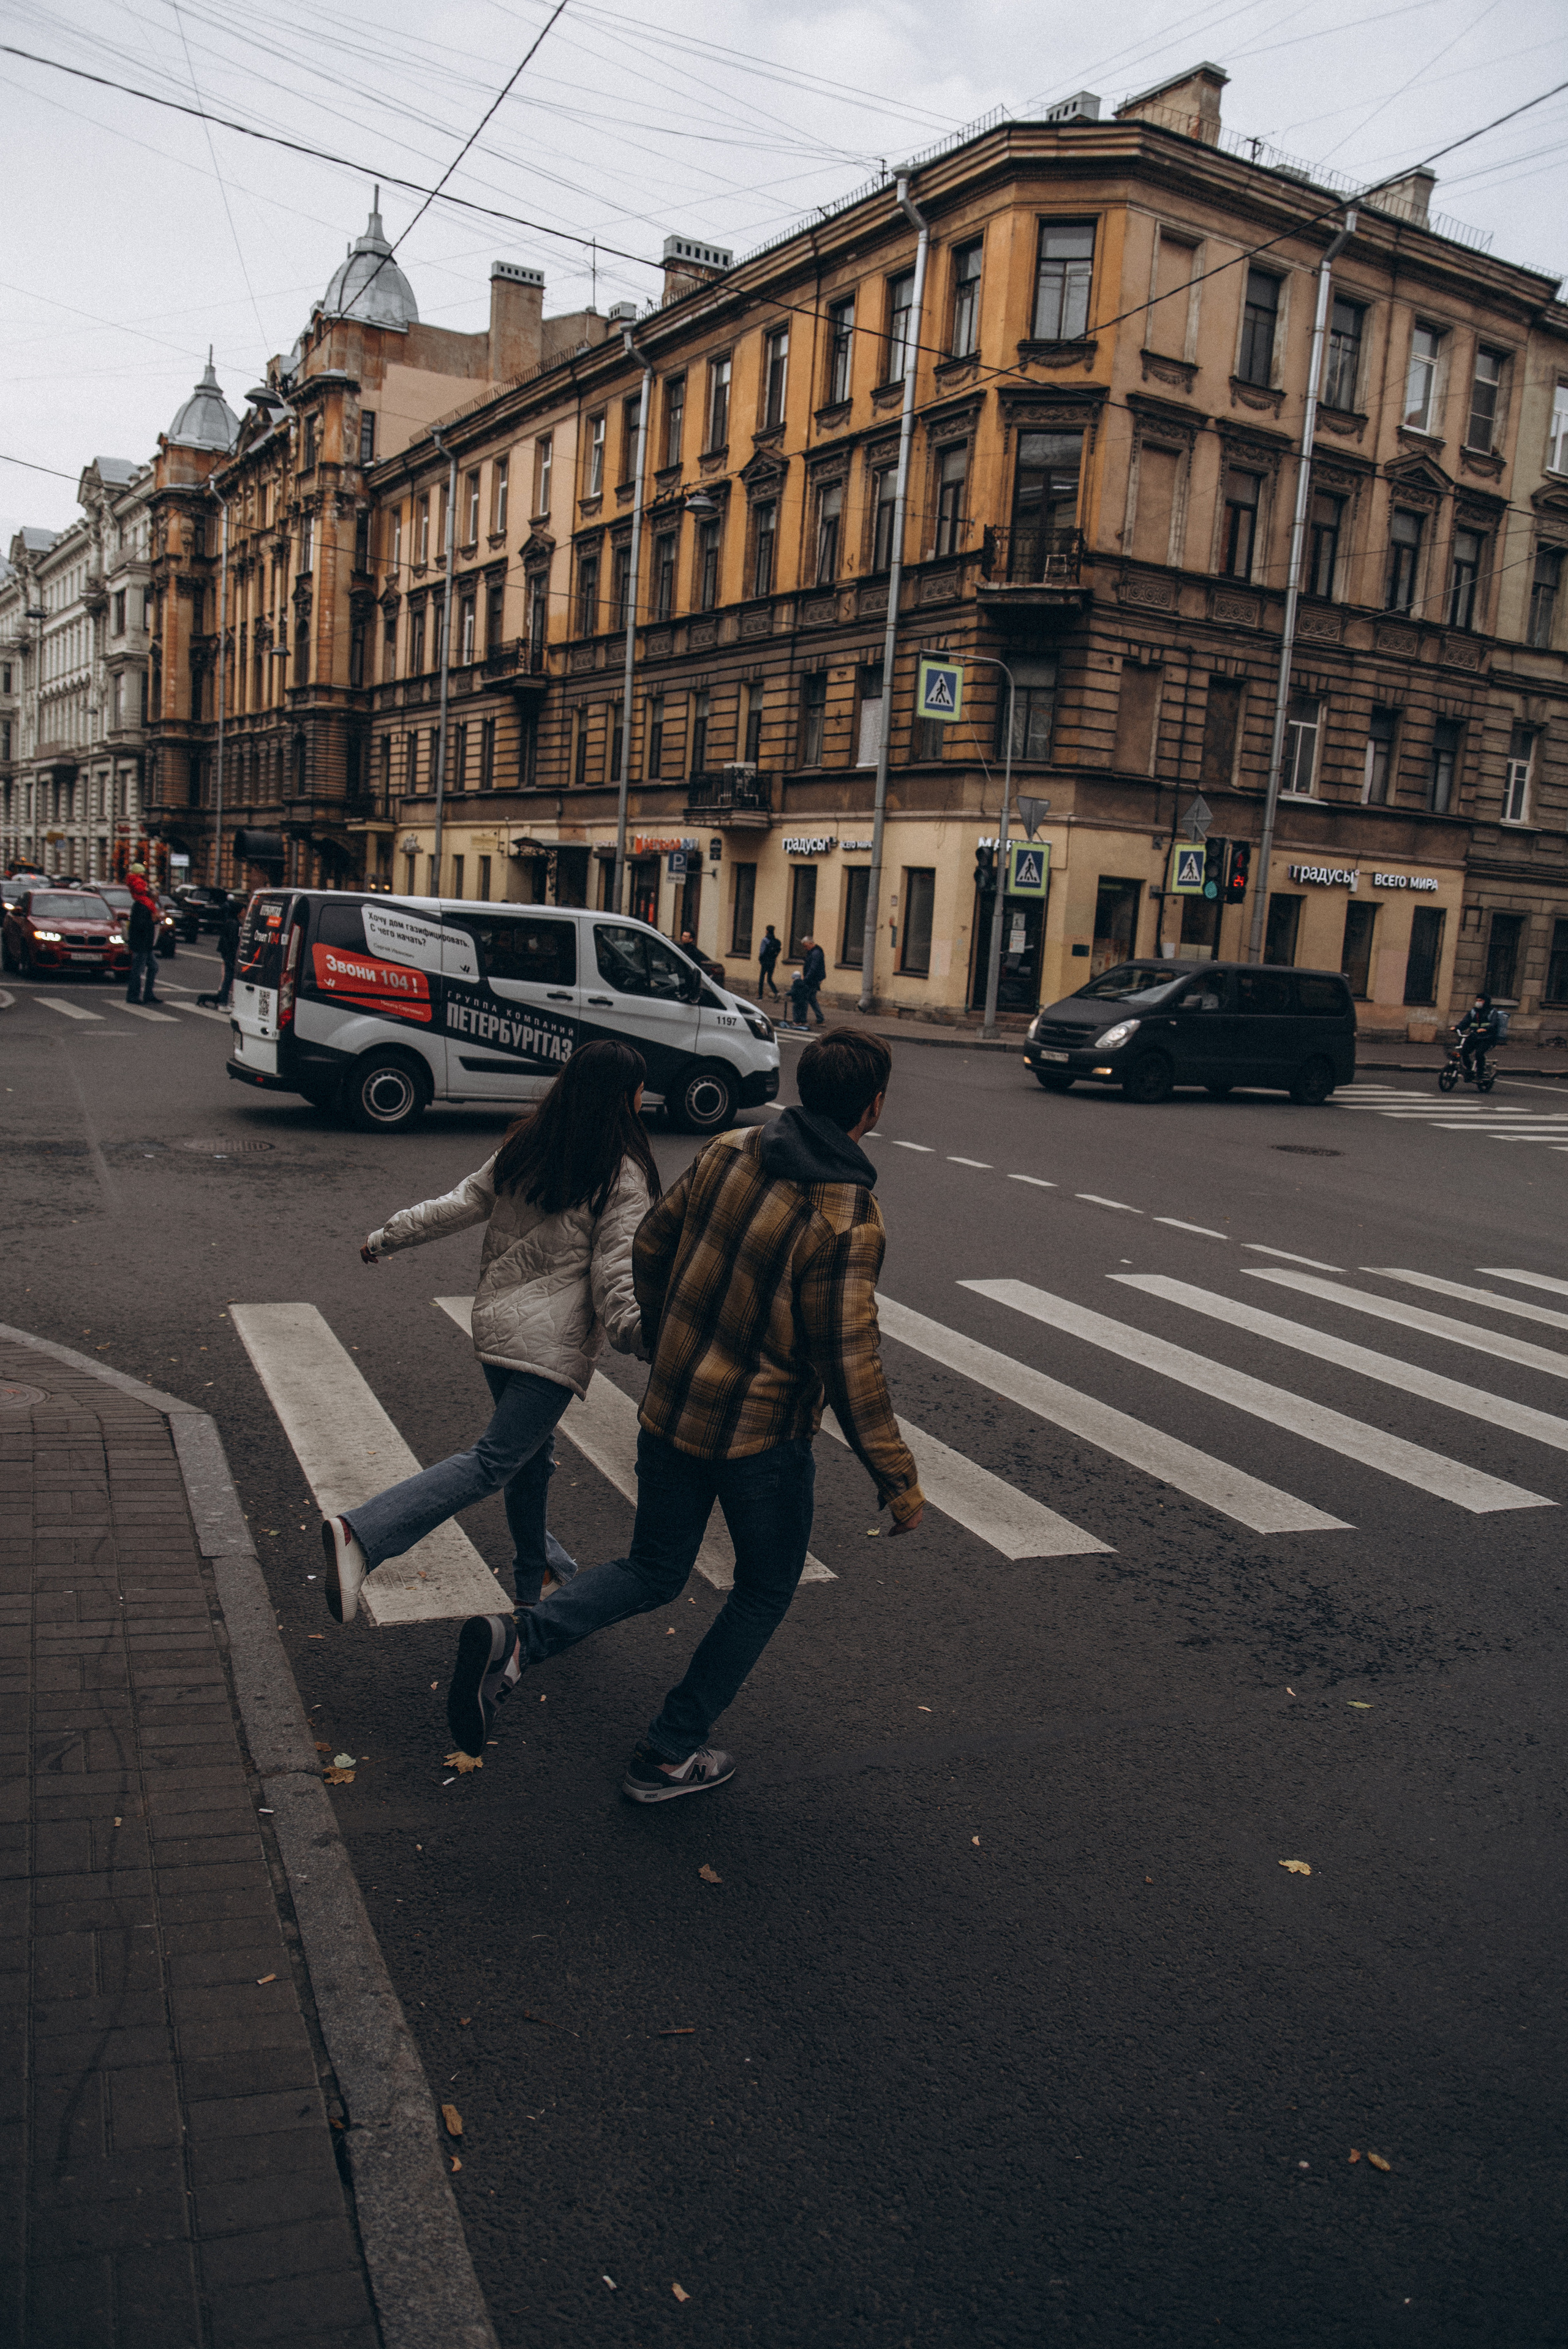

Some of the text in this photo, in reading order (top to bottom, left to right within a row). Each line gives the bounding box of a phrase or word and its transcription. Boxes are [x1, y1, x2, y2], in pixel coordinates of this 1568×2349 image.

[1374, 874, 1406, 887] ВСЕГО
[1410, 877, 1438, 890] МИРА
[368, 912, 386, 924] Хочу
[390, 919, 404, 929] дом
[371, 923, 426, 947] С чего начать?
[326, 954, 376, 982] Звони
[447, 990, 574, 1037] ГРУППА КОМПАНИЙ
[717, 1016, 737, 1026] 1197
[447, 1002, 573, 1063] ПЕТЕРБУРГГАЗ
